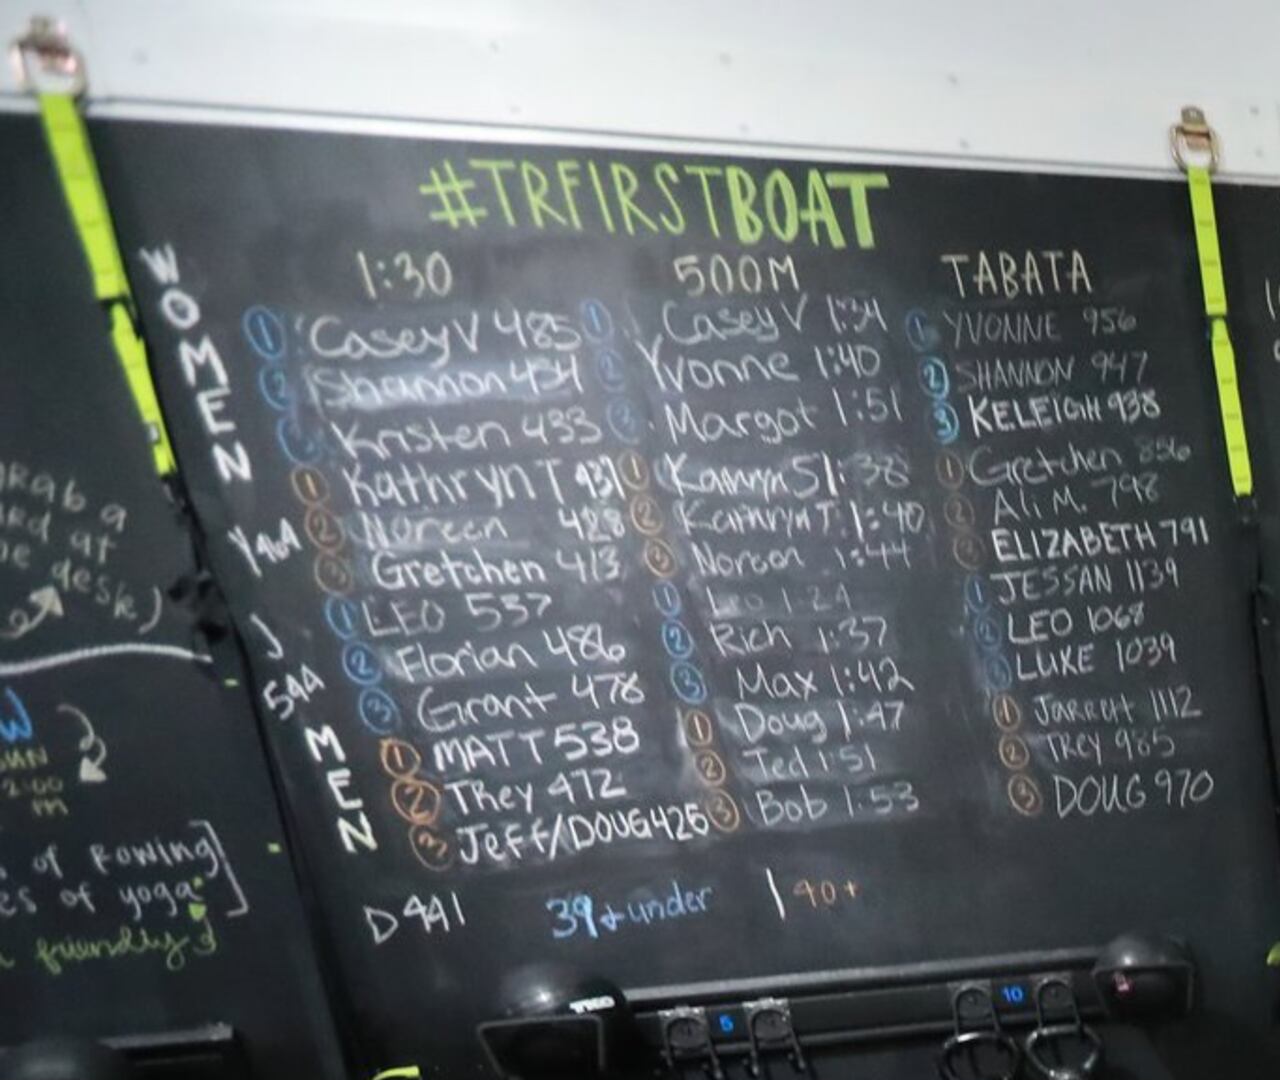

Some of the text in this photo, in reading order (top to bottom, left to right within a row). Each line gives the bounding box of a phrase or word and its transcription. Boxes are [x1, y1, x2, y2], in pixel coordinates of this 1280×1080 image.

[417, 161, 889, 250] #TRFIRSTBOAT
[358, 250, 452, 298] 1:30
[674, 253, 799, 297] 500M
[941, 251, 1092, 299] TABATA
[310, 315, 449, 369] Casey
[494, 308, 581, 350] 485
[663, 299, 779, 345] Casey
[945, 308, 1137, 349] YVONNE 956
[635, 334, 880, 393] Yvonne 1:40
[955, 350, 1149, 394] SHANNON 947
[522, 406, 603, 443] 433
[663, 387, 903, 445] Margot 1:51
[967, 393, 1102, 438] KELEIGH
[343, 459, 536, 508] Kathryn
[969, 442, 1123, 487] Gretchen
[991, 515, 1210, 562] ELIZABETH 791
[372, 548, 622, 590] Gretchen 413
[990, 557, 1179, 605] JESSAN 1139
[362, 591, 552, 636] LEO 537
[1007, 602, 1145, 645] LEO 1068
[393, 623, 626, 683] Florian 486
[709, 615, 887, 658] Rich 1:37
[1016, 633, 1177, 681] LUKE 1039
[736, 656, 916, 700] Max 1:42
[417, 672, 645, 732] Grant 478
[735, 700, 906, 744] Doug 1:47
[1150, 686, 1203, 721] 1112
[432, 715, 641, 773] MATT 538
[742, 744, 809, 780] Ted
[548, 769, 627, 804] 472
[755, 783, 827, 827] Bob
[1053, 770, 1214, 819] DOUG 970
[546, 879, 712, 940] 39 under
[1002, 984, 1024, 1003] 10
